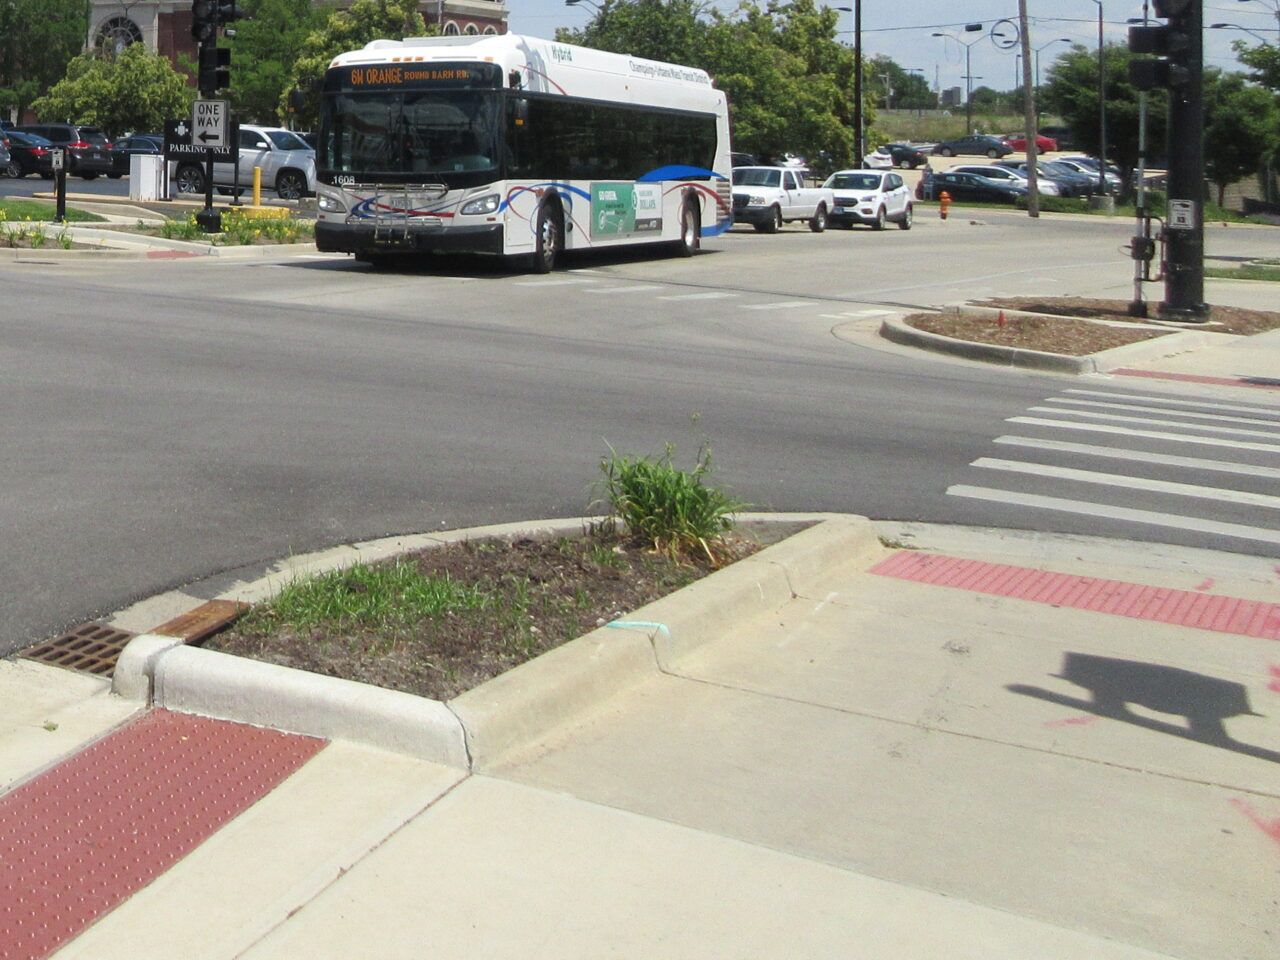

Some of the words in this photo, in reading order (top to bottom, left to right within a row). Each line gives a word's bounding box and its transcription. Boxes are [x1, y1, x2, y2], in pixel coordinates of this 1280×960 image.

[551, 44, 573, 63] Hybrid
[366, 67, 403, 84] ORANGE
[198, 104, 219, 115] ONE
[197, 117, 220, 128] WAY
[169, 143, 207, 154] PARKING
[333, 175, 356, 184] 1608
